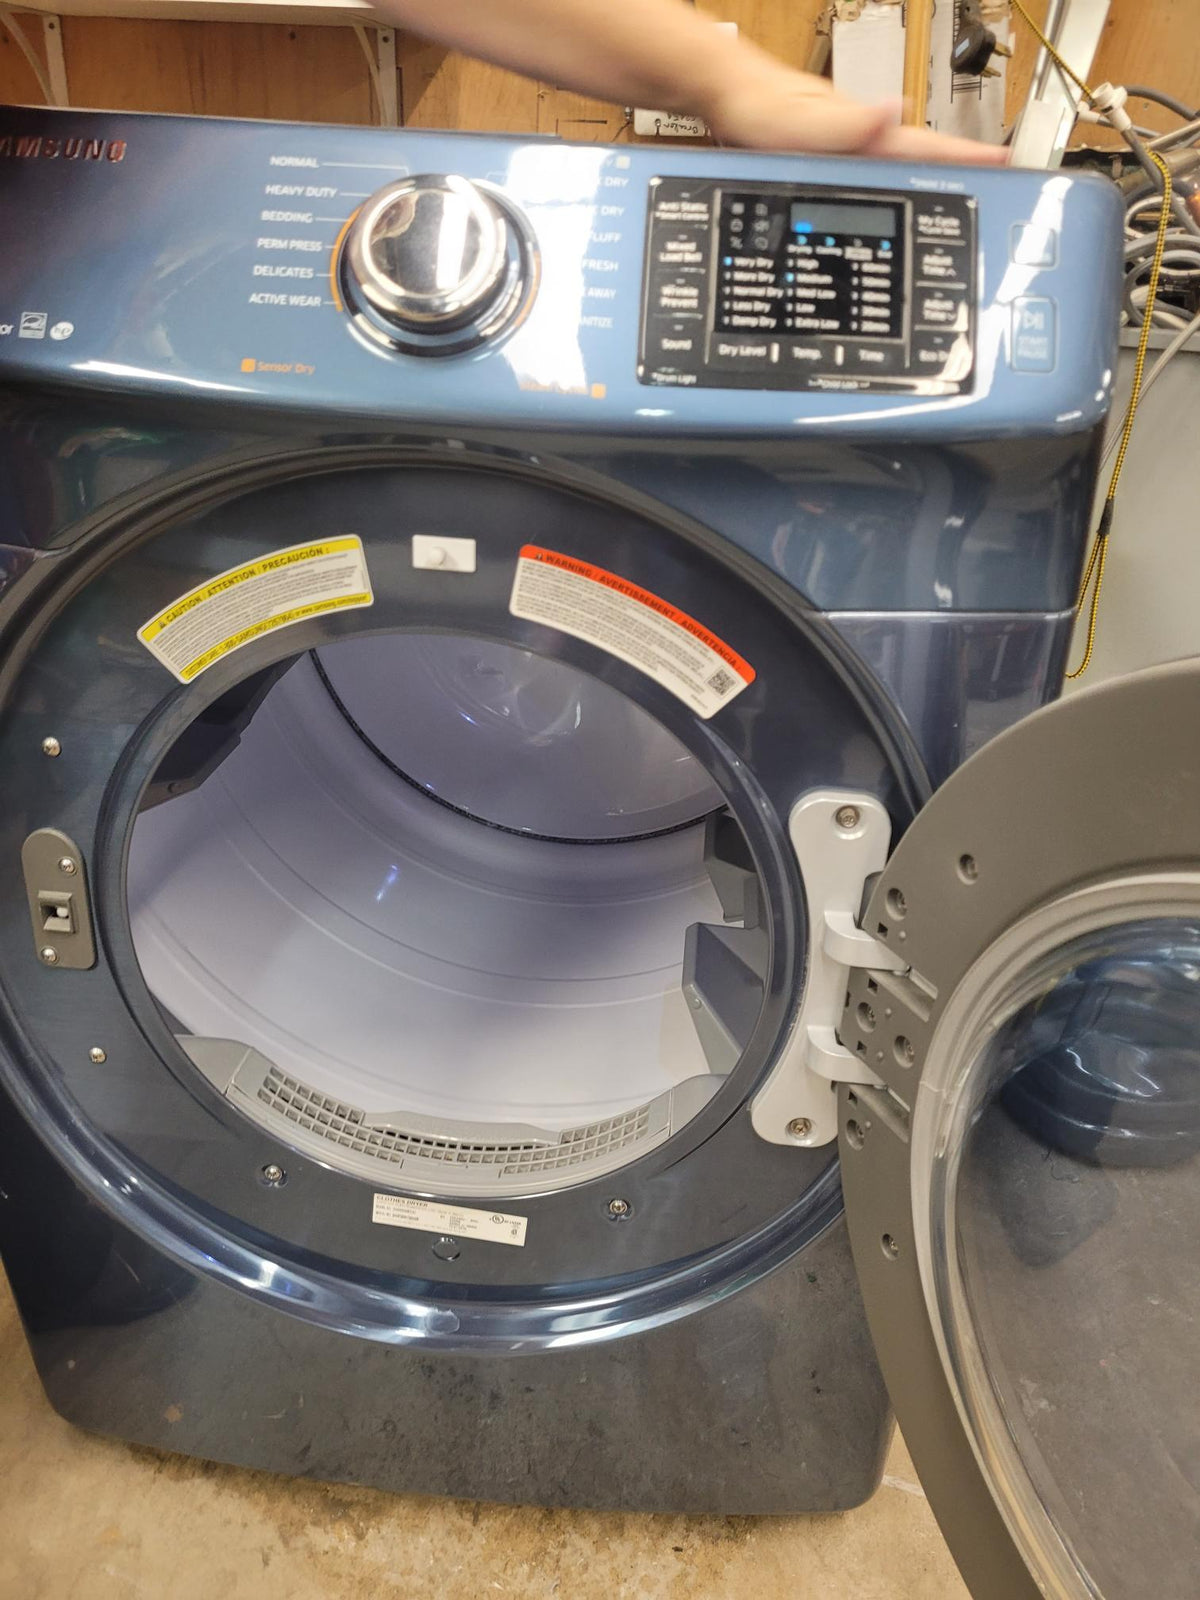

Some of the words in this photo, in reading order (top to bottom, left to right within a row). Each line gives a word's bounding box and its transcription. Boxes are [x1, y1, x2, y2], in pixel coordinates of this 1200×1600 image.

[0, 138, 127, 163] AMSUNG
[269, 156, 320, 169] NORMAL
[604, 176, 629, 187] DRY
[265, 184, 304, 197] HEAVY
[305, 187, 338, 198] DUTY
[260, 210, 313, 223] BEDDING
[601, 205, 625, 216] DRY
[590, 231, 622, 243] LUFF
[256, 237, 289, 250] PERM
[289, 239, 322, 252] PRESS
[582, 258, 619, 271] FRESH
[756, 257, 774, 269] Dry
[252, 265, 314, 279] DELICATES
[758, 271, 776, 284] Dry
[249, 292, 293, 305] ACTIVE
[293, 295, 322, 307] WEAR
[766, 287, 784, 299] Dry
[753, 301, 771, 314] Dry
[758, 315, 777, 329] Dry
[718, 343, 738, 357] Dry
[740, 345, 767, 357] Level
[257, 361, 293, 373] Sensor
[295, 363, 316, 376] Dry
[166, 597, 202, 622] CAUTION
[207, 569, 256, 597] ATTENTION
[262, 547, 324, 571] PRECAUCIÓN
[545, 554, 592, 578] WARNING
[600, 575, 676, 618] AVERTISSEMENT
[681, 620, 737, 667] ADVERTENCIA
